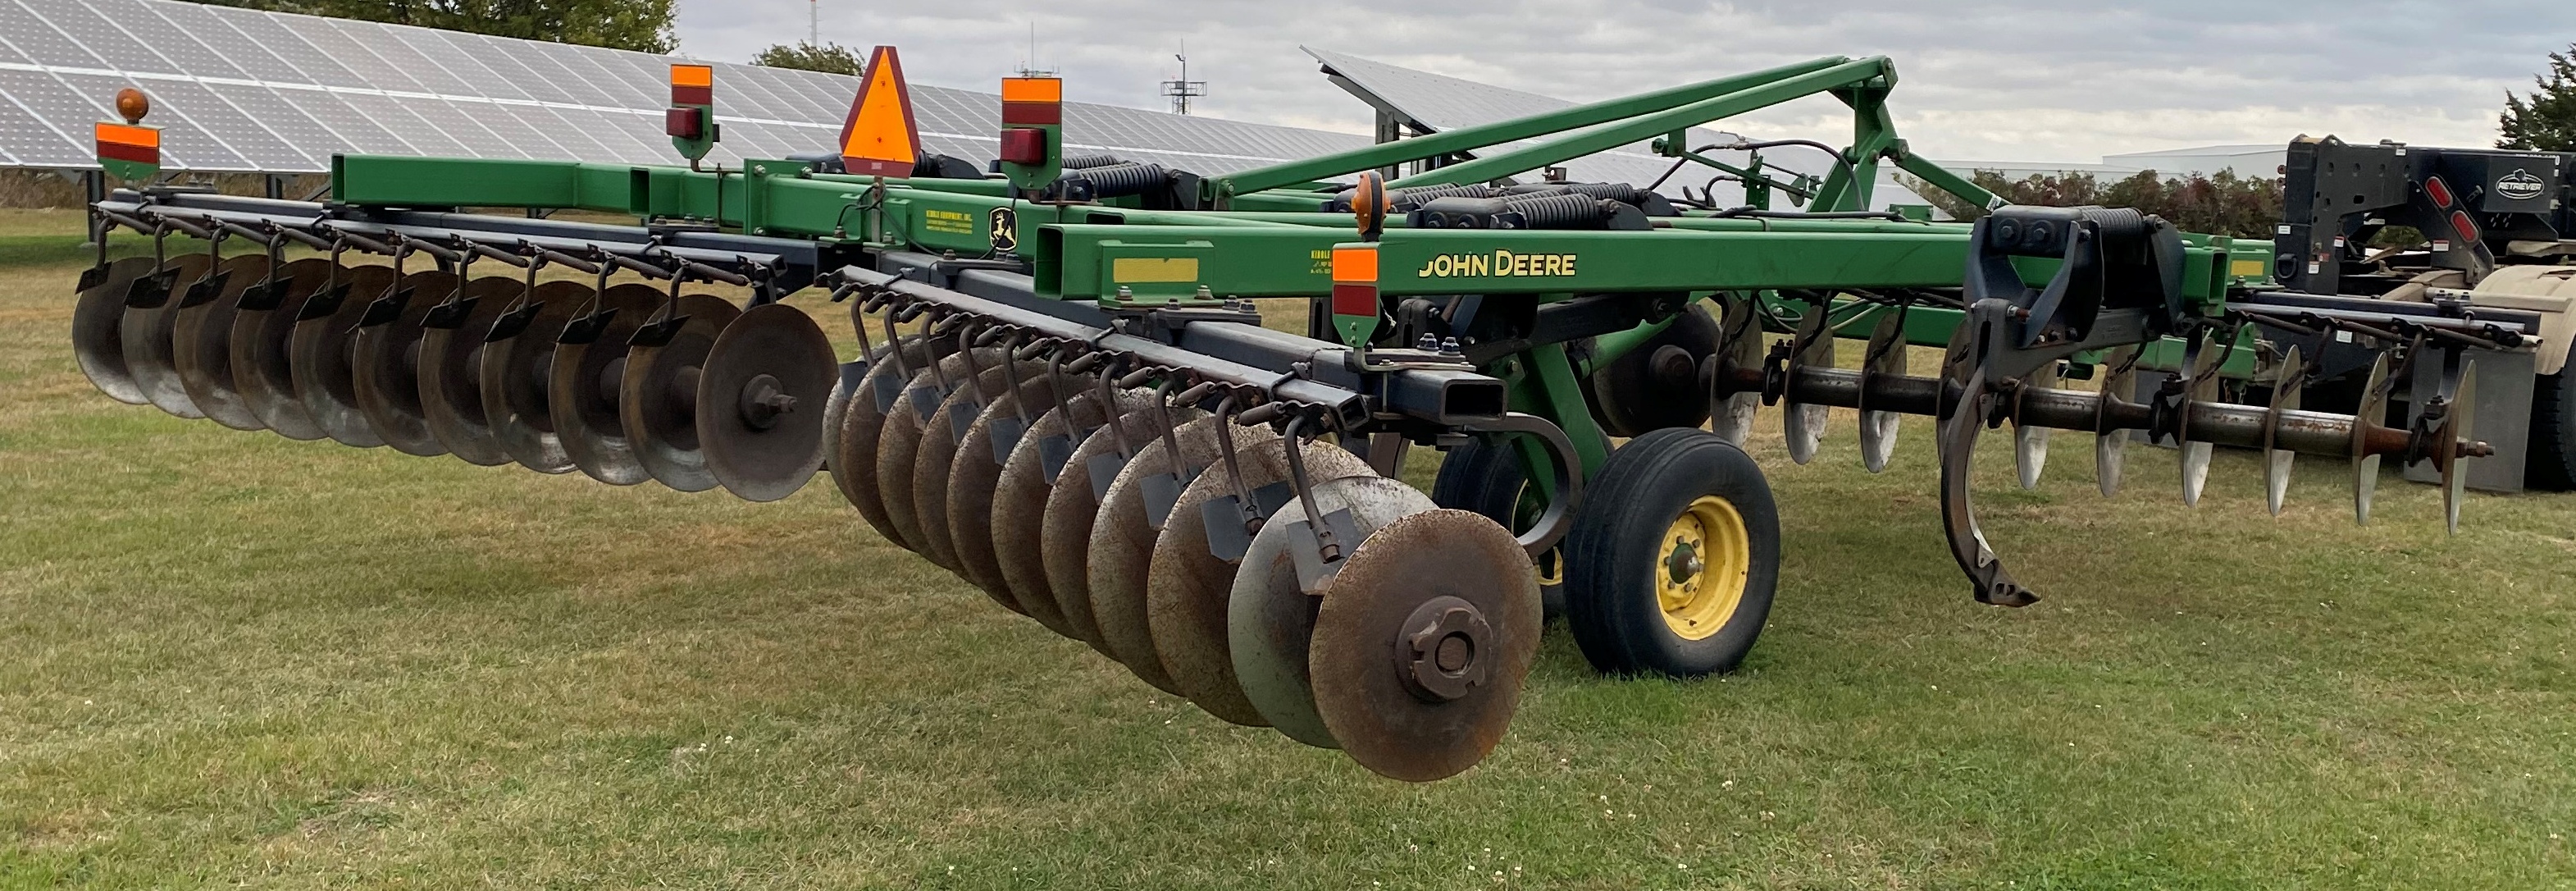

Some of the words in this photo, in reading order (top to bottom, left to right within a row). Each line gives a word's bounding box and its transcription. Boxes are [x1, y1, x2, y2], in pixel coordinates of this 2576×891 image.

[2497, 181, 2542, 191] RETRIEVER
[1418, 254, 1489, 277] JOHN
[1493, 249, 1576, 277] DEERE
